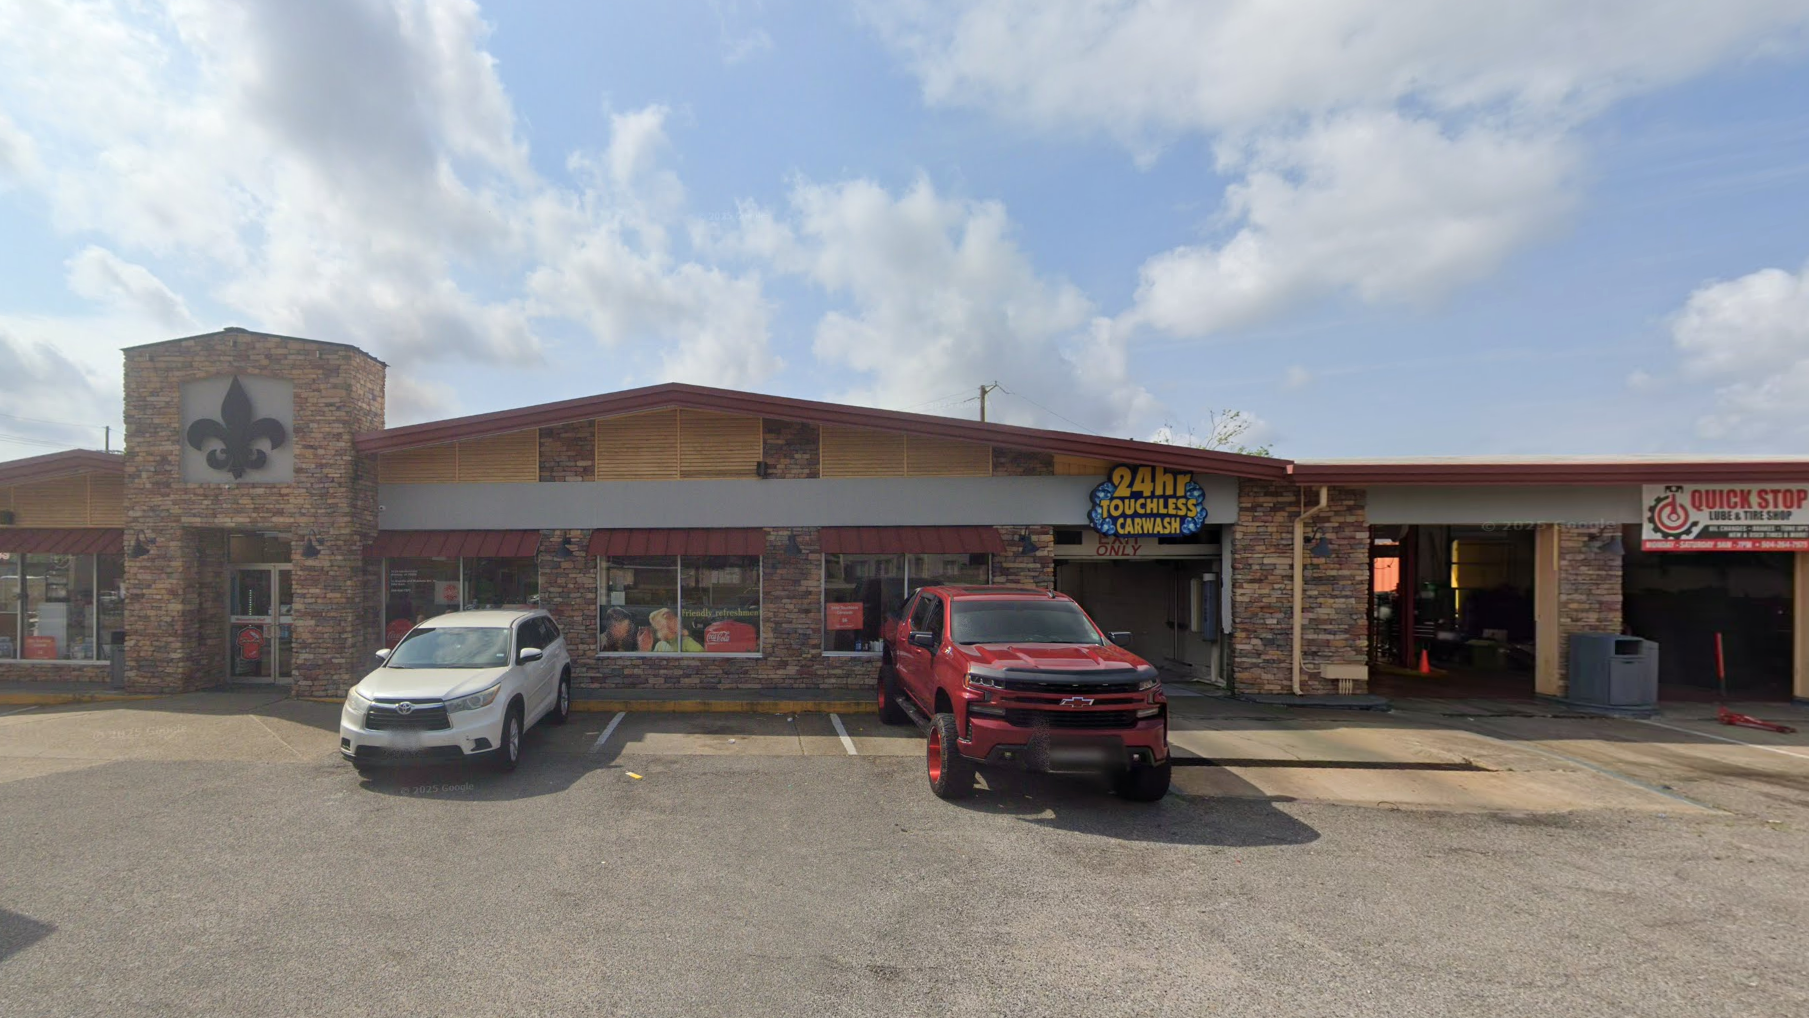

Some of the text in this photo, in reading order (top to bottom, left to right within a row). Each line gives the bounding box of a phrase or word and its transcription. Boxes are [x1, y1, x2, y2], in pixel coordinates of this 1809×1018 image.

[1112, 466, 1192, 497] 24hr
[1100, 498, 1198, 518] TOUCHLESS
[1690, 489, 1808, 511] QUICK STOP
[1709, 510, 1793, 521] LUBE & TIRE SHOP
[1116, 517, 1180, 534] CARWASH
[1096, 545, 1141, 556] ONLY
[681, 607, 713, 618] Friendly
